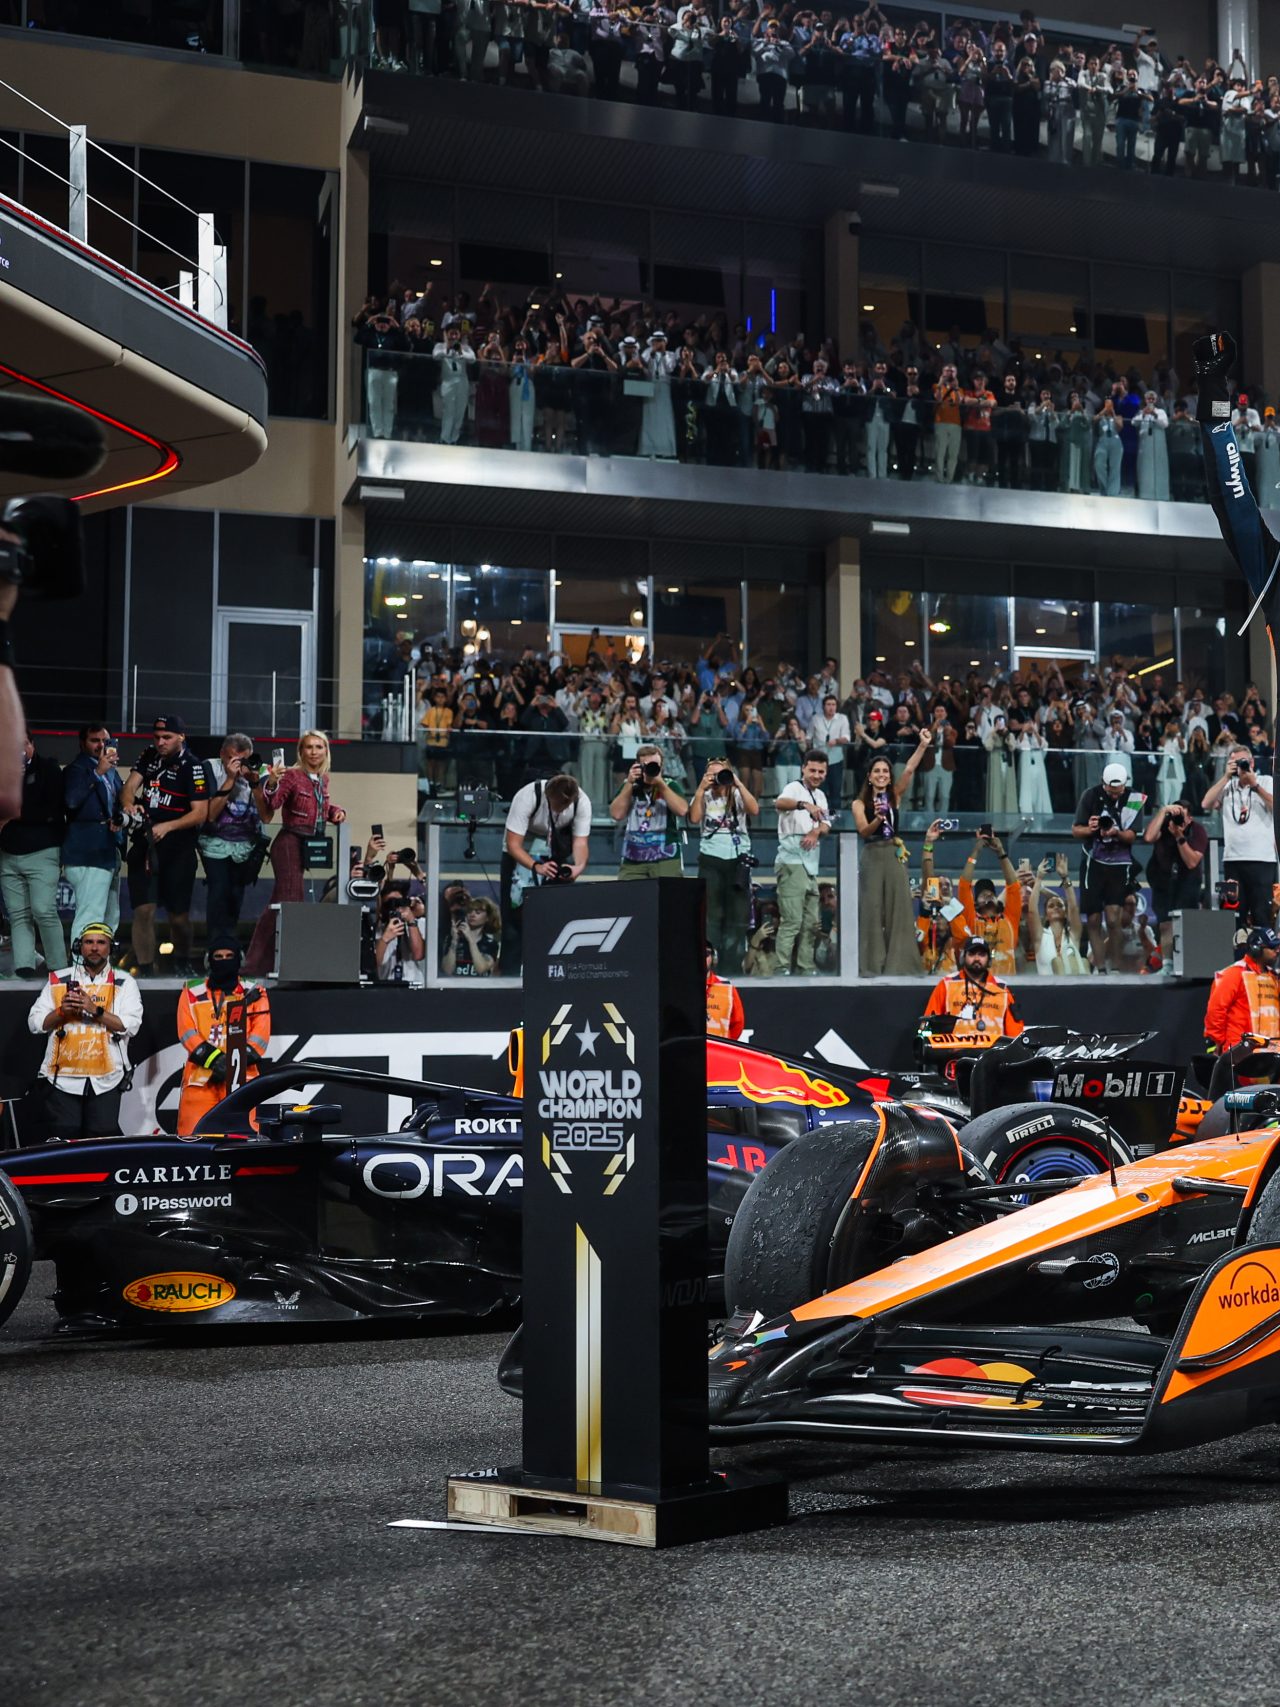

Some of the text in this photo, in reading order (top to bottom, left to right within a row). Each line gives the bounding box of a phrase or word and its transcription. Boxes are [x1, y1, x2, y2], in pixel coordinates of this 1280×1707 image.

[1225, 442, 1246, 499] allwyn
[932, 1034, 991, 1045] allwyn
[231, 1048, 240, 1093] 2
[538, 1069, 642, 1099] WORLD
[1054, 1072, 1142, 1098] Mobil
[538, 1098, 643, 1120] CHAMPION
[455, 1118, 522, 1135] ROKT
[553, 1122, 624, 1151] 2025
[1006, 1114, 1055, 1144] PIRELLI
[115, 1164, 232, 1184] CARLYLE
[362, 1153, 523, 1199] ORA
[141, 1192, 232, 1212] 1Password
[1187, 1227, 1238, 1245] McLare
[153, 1282, 222, 1301] RAUCH
